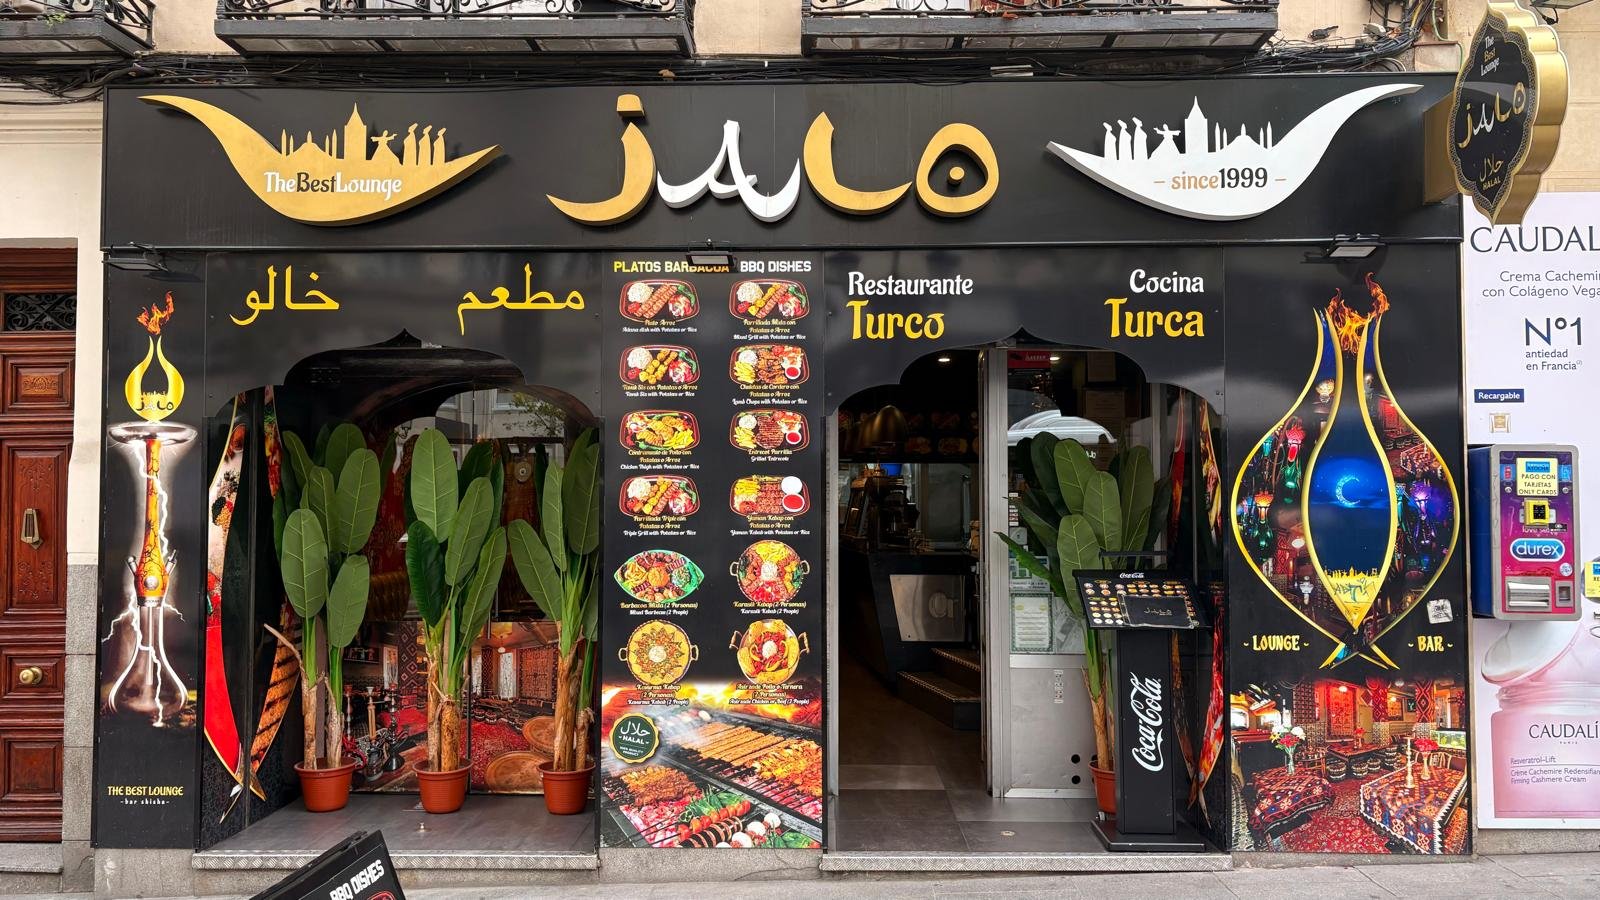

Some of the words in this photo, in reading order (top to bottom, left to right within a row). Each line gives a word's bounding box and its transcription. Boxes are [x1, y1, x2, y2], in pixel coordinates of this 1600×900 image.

[1485, 36, 1494, 48] The
[1482, 177, 1502, 190] HALAL
[614, 261, 661, 273] PLATOS
[740, 261, 765, 273] BBQ
[768, 261, 811, 273] DISHES
[848, 271, 974, 296] Restaurante
[1129, 268, 1205, 294] Cocina
[1499, 270, 1541, 282] Crema
[229, 264, 340, 326] خالو
[457, 262, 585, 336] مطعم
[1482, 288, 1504, 297] con
[1509, 285, 1569, 299] Colágeno
[846, 299, 945, 340] Turco
[1104, 297, 1205, 338] Turca
[1526, 349, 1568, 358] antiedad
[1478, 392, 1520, 401] Recargable
[1516, 541, 1560, 556] durex
[1252, 634, 1300, 651] LOUNGE
[1417, 636, 1444, 652] BAR
[620, 721, 650, 737] حلال
[1529, 721, 1598, 738] CAUDALÍ
[622, 735, 644, 744] HALAL
[108, 786, 124, 796] THE
[126, 786, 147, 795] BEST
[149, 786, 184, 795] LOUNGE
[350, 859, 384, 894] DISHES
